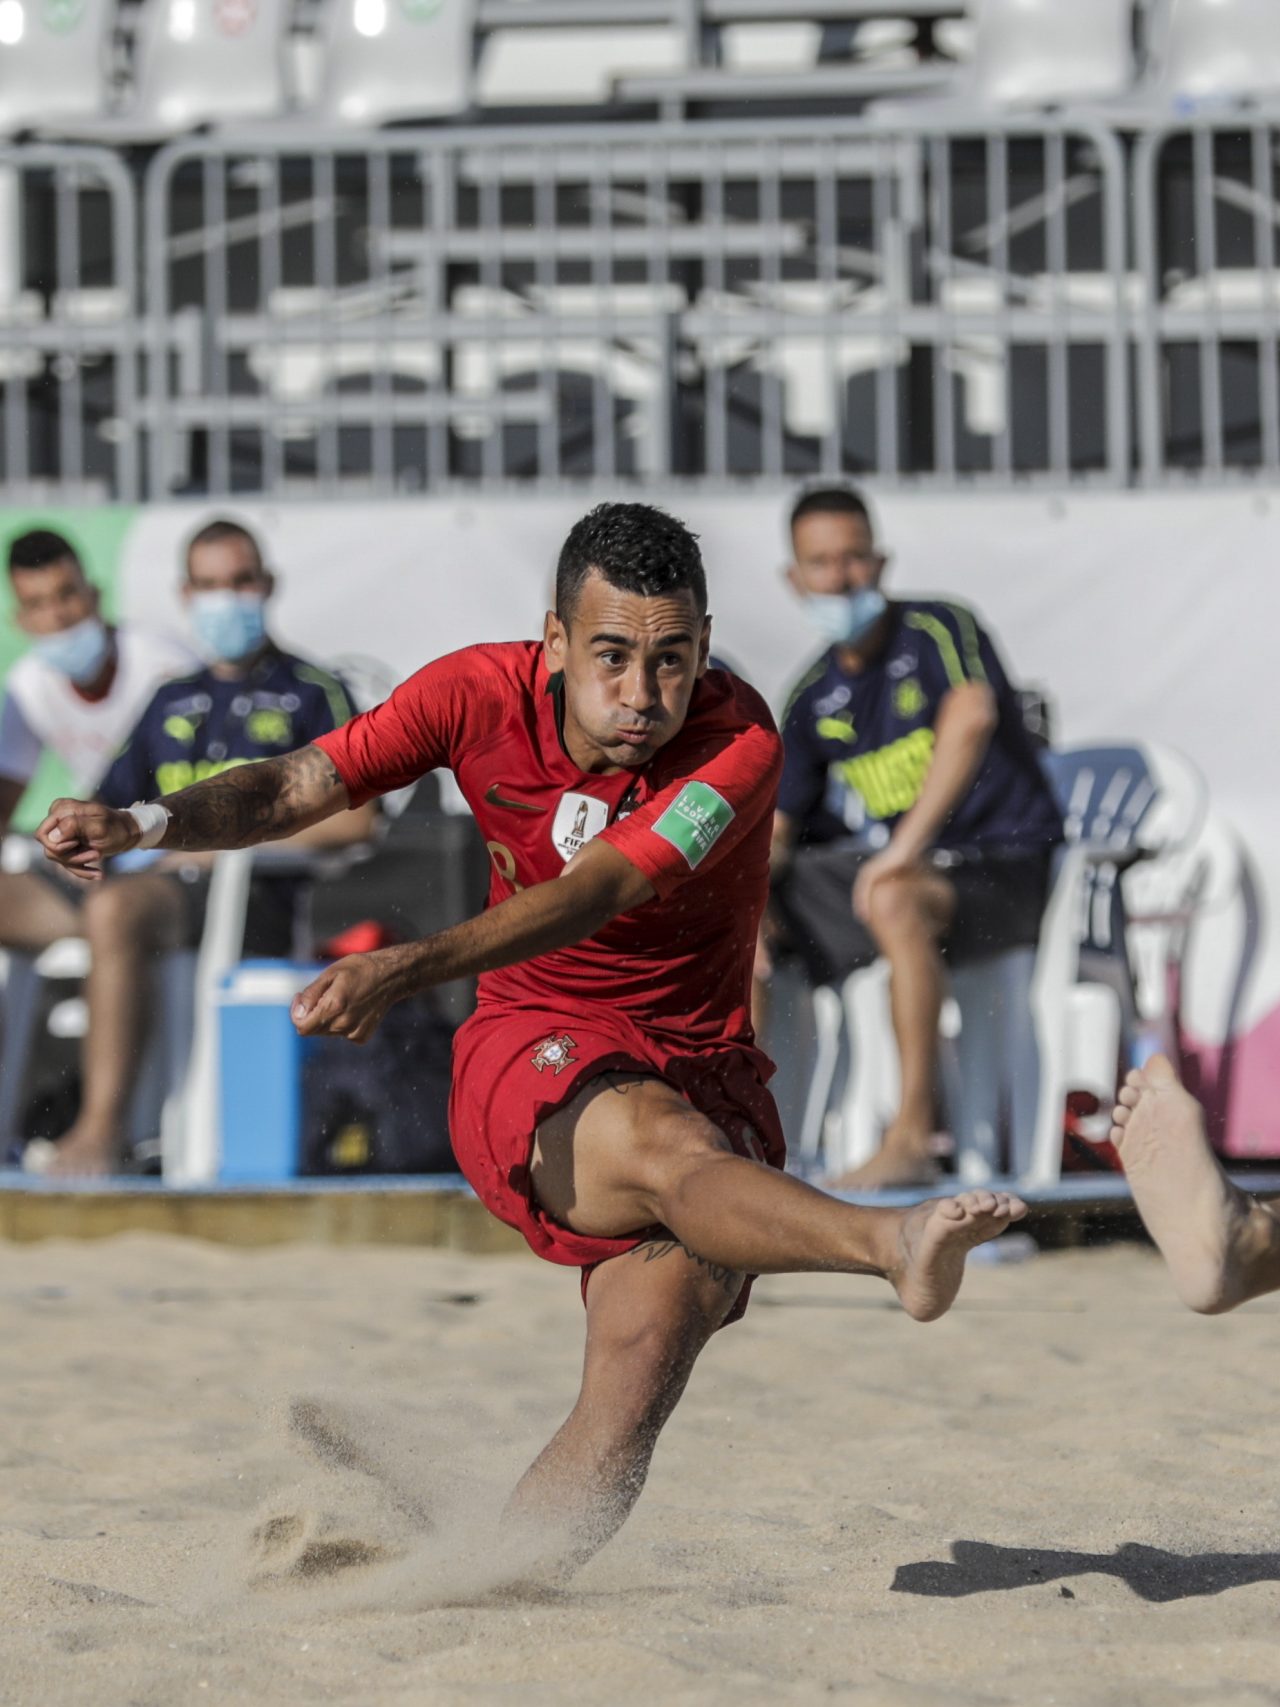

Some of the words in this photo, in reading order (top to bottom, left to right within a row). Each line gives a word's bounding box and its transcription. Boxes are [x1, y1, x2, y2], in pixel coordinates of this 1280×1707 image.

[677, 801, 715, 838] FOOTBALL
[682, 795, 720, 832] LIVING
[691, 829, 707, 850] FIFA
